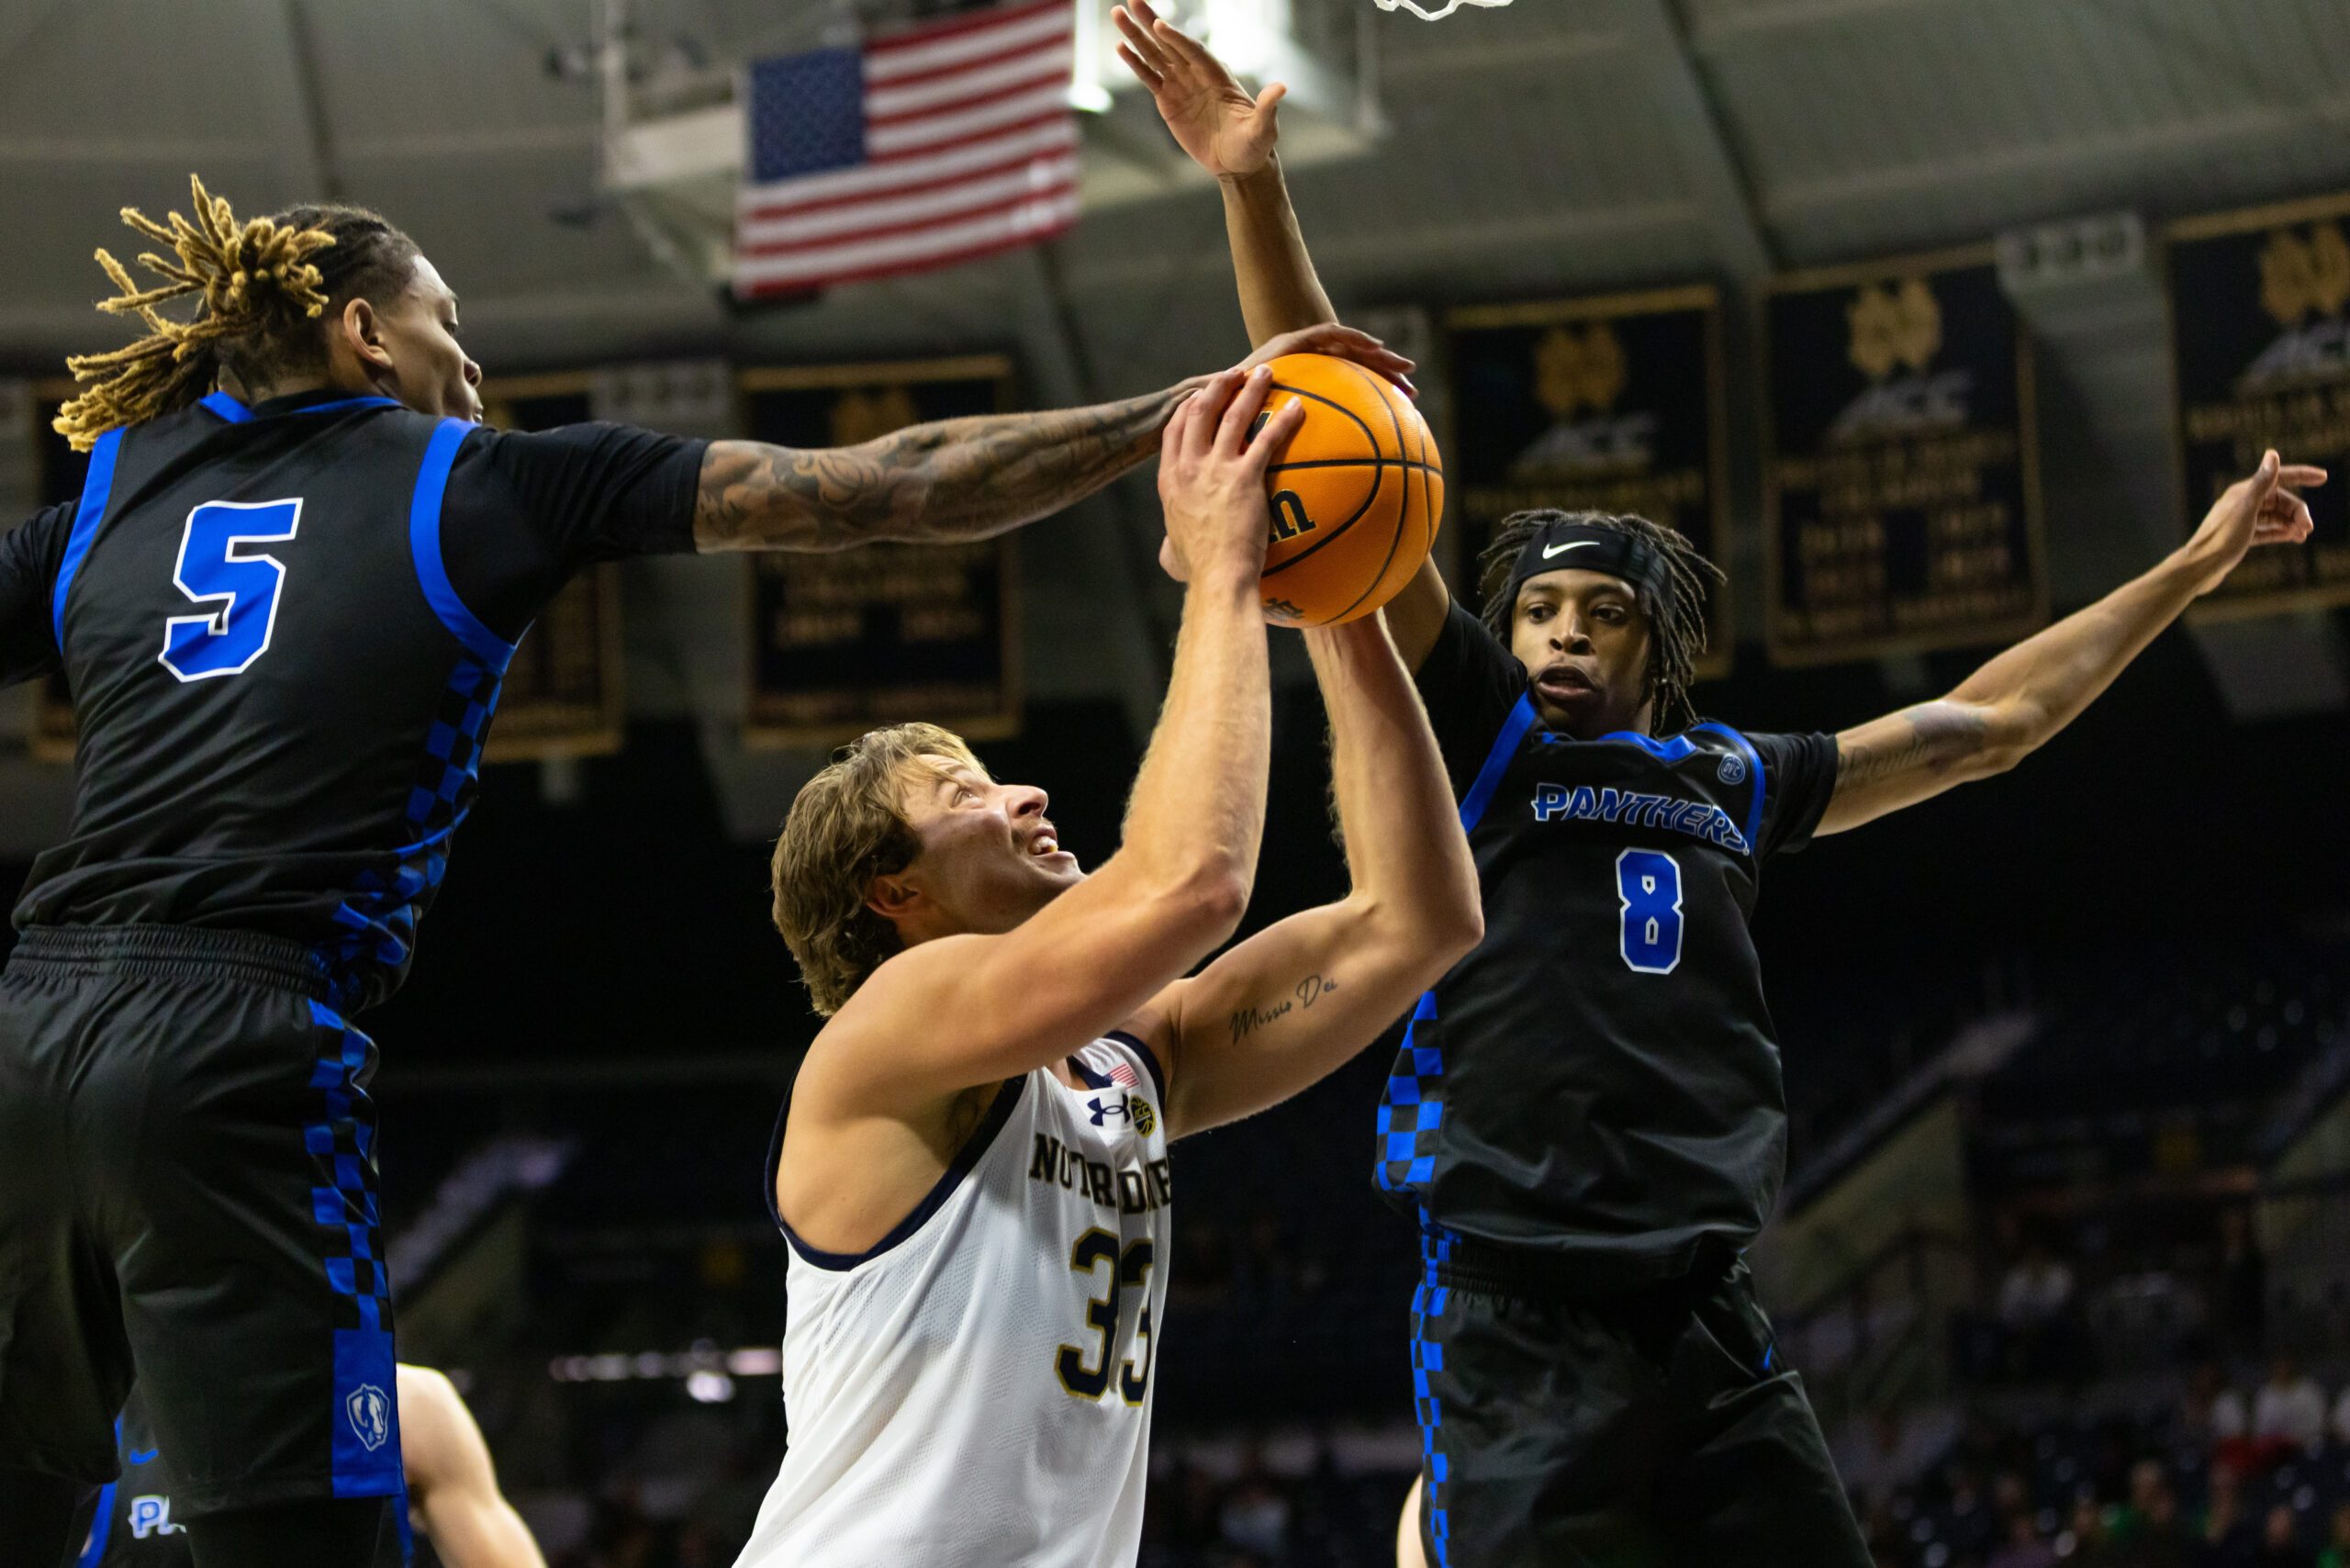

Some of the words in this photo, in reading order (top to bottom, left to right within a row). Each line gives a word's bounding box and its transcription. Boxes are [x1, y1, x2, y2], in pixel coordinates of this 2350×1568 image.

[158, 497, 304, 682] 5
[1531, 782, 1751, 857] PANTHERS
[1616, 846, 1684, 975] 8
[1055, 1226, 1155, 1408] 33
